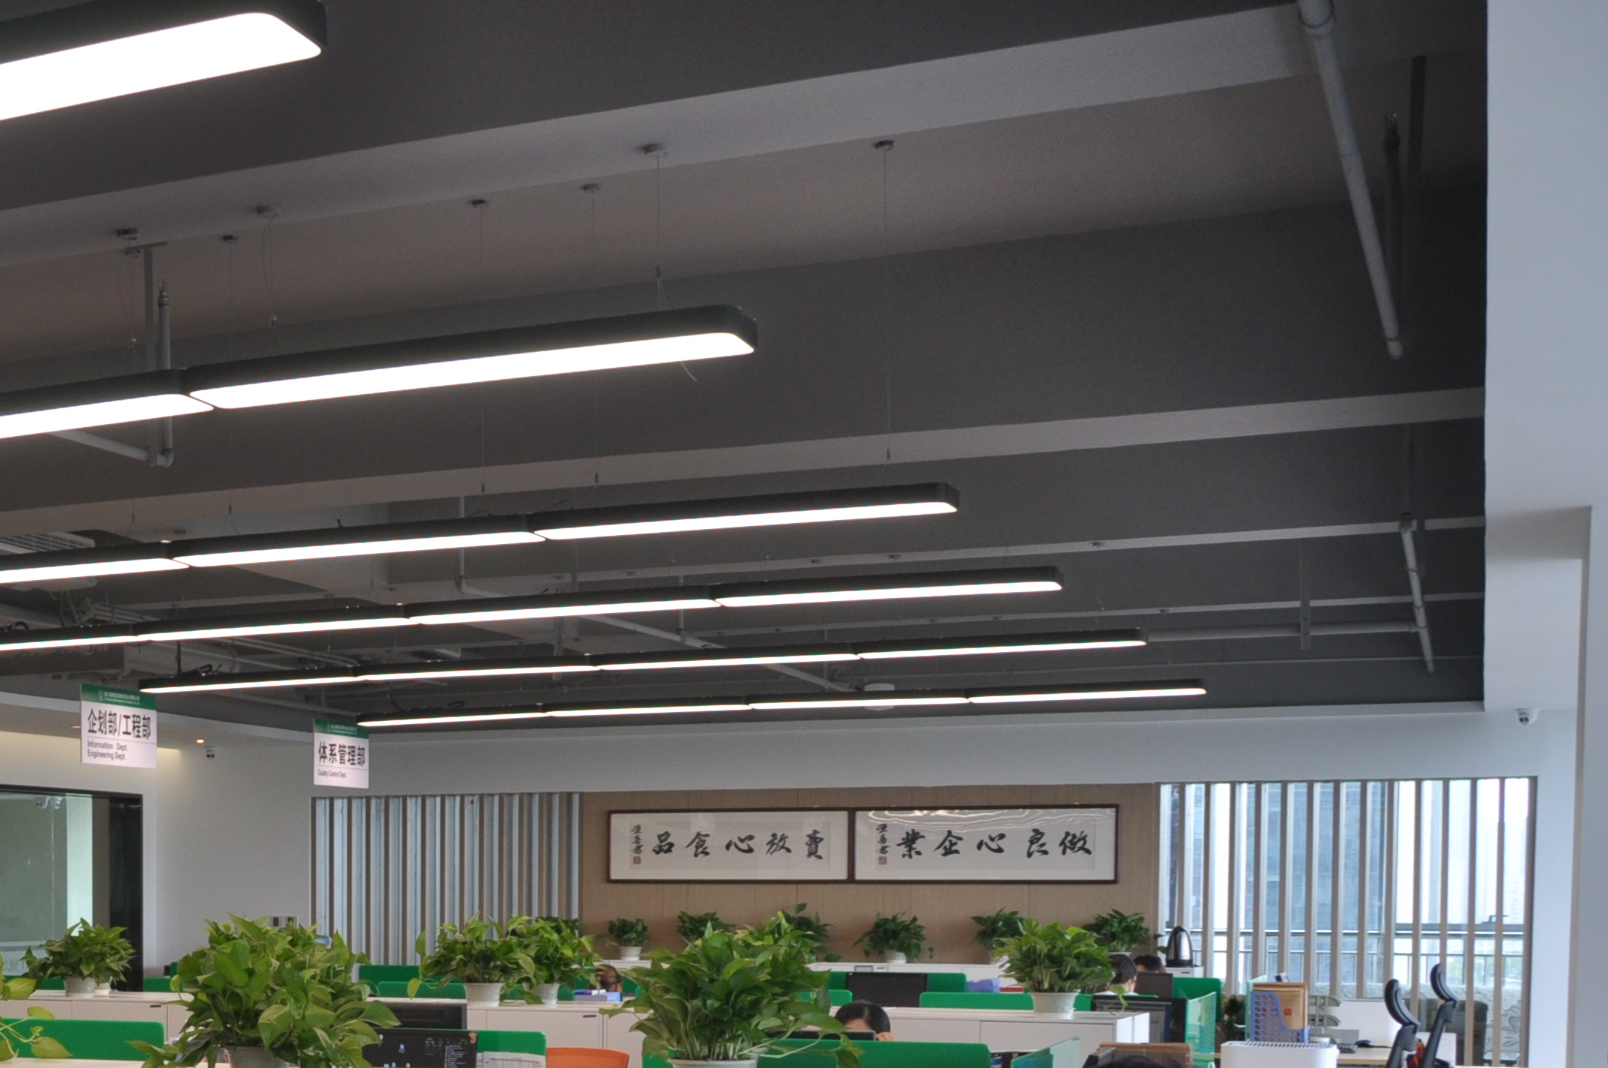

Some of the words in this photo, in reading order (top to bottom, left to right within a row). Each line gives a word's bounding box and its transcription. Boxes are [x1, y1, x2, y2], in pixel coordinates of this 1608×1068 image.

[87, 708, 151, 740] 企划部/工程部
[318, 741, 366, 767] 体系管理部
